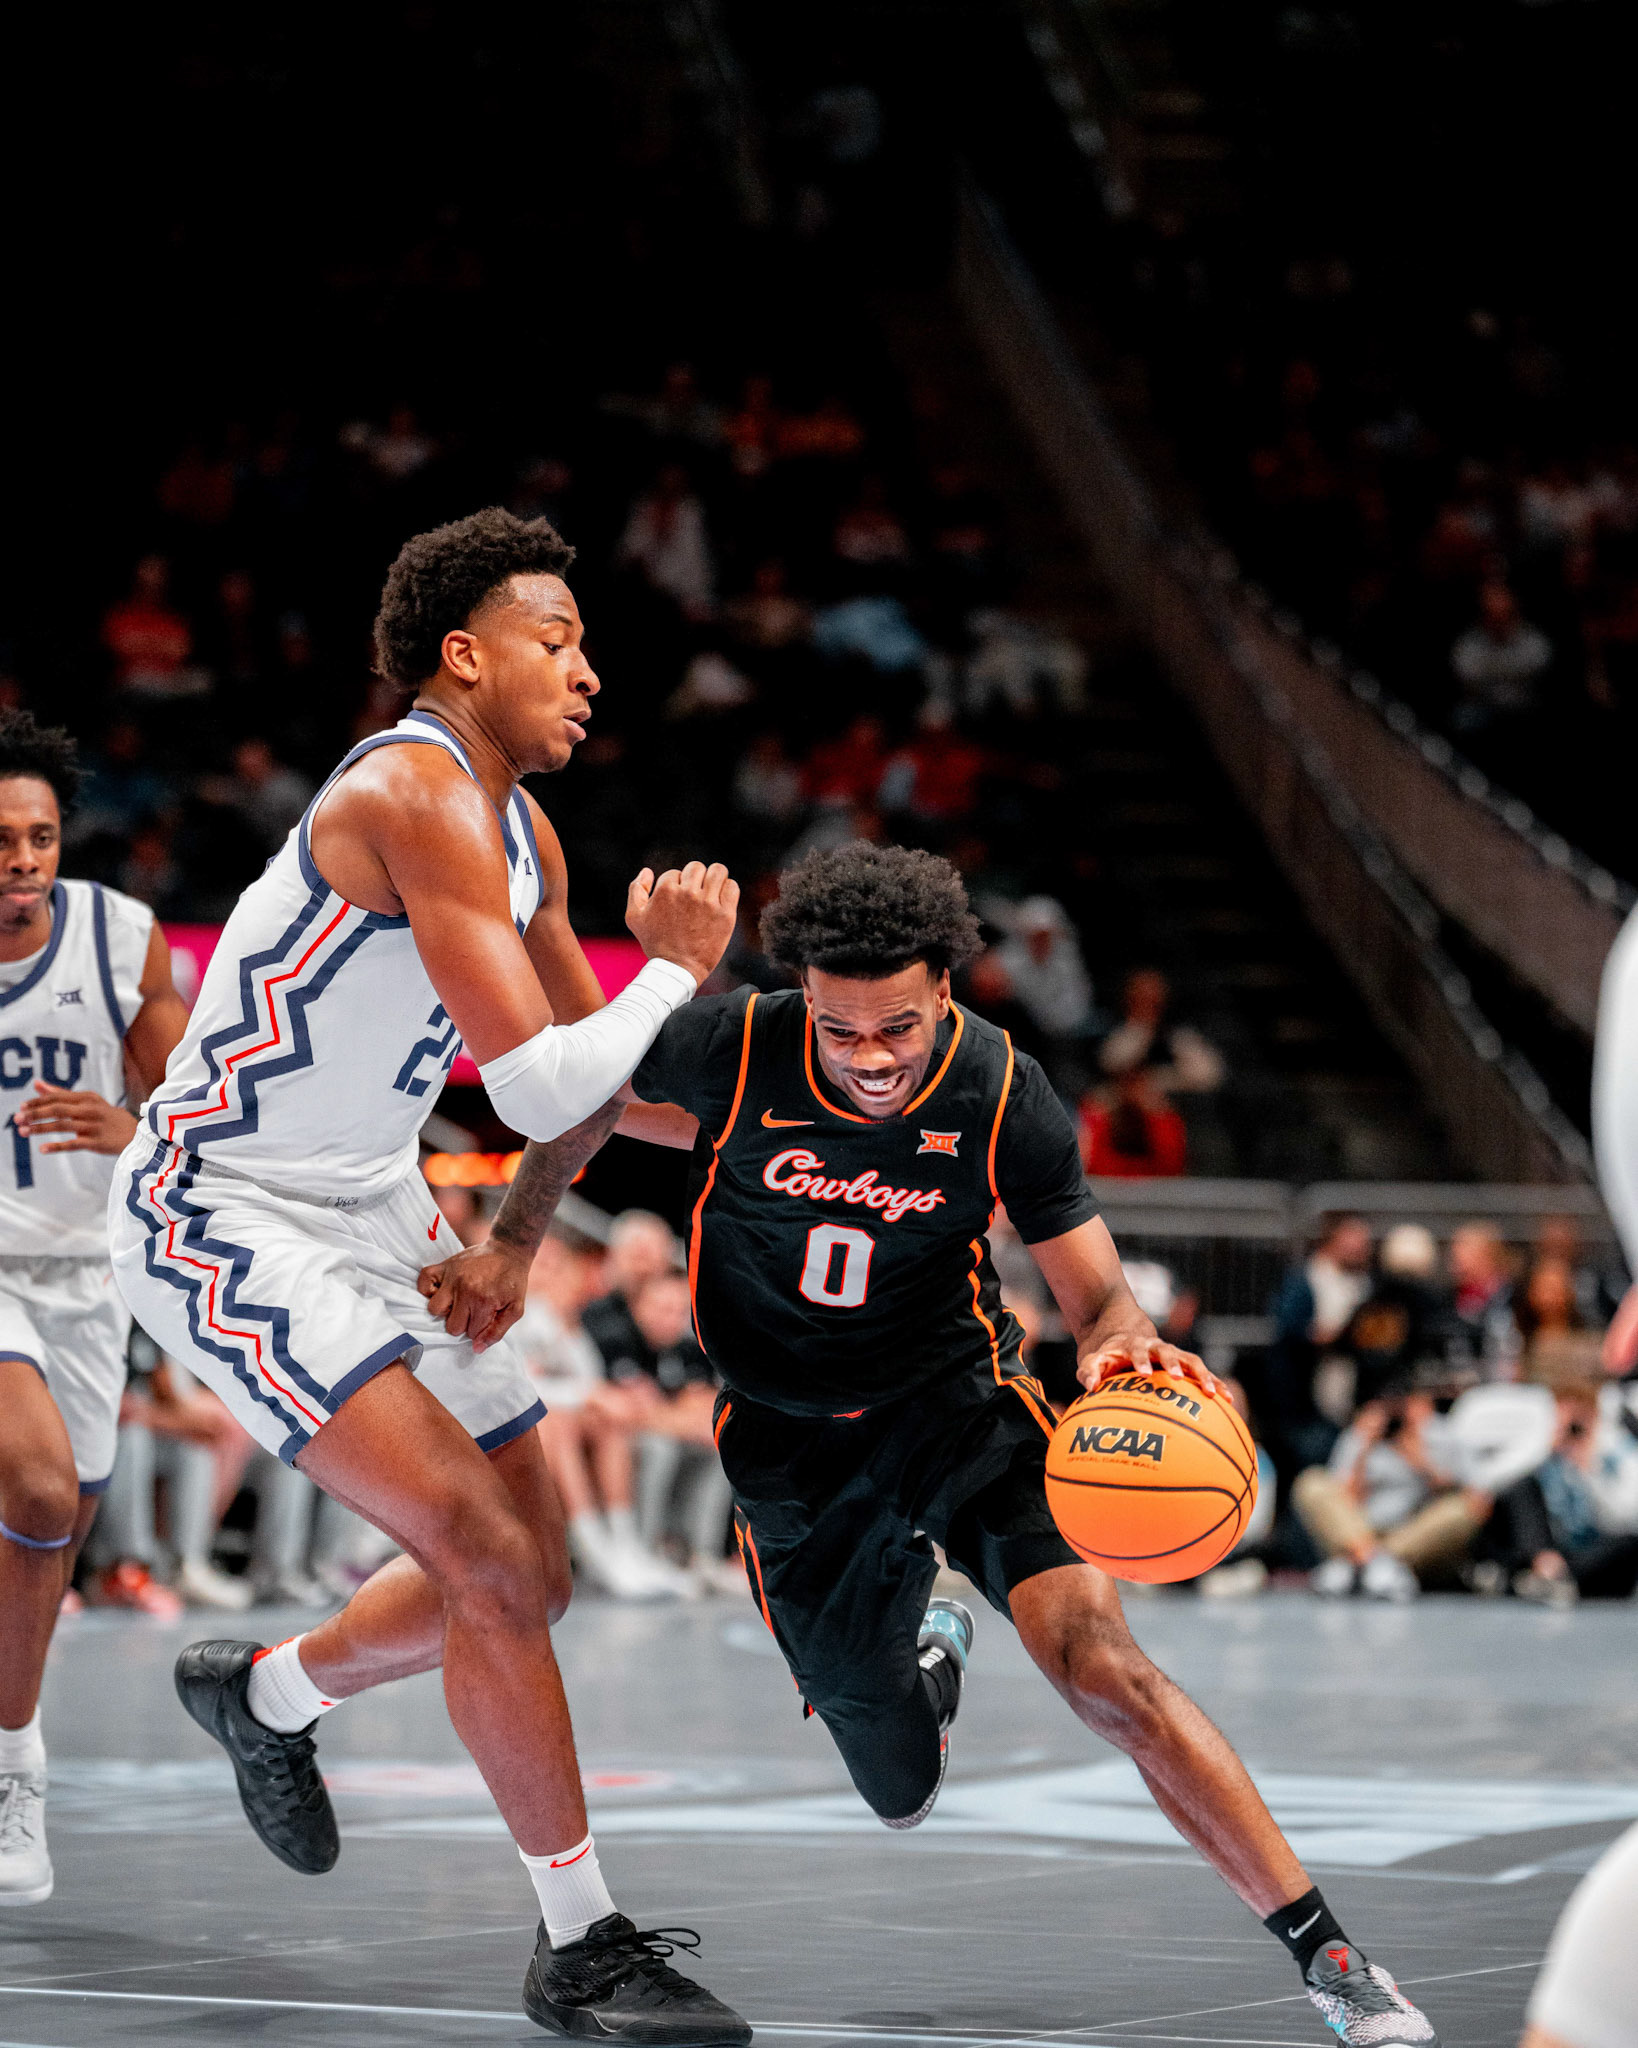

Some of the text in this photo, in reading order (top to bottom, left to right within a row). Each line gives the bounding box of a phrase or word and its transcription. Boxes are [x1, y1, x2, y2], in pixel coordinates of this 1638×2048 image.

[0, 1036, 87, 1089] CU
[919, 1131, 961, 1156] XII
[763, 1148, 946, 1223] Cowboys
[798, 1222, 876, 1308] 0
[1069, 1426, 1166, 1463] NCAA
[1132, 1461, 1159, 1471] BALL
